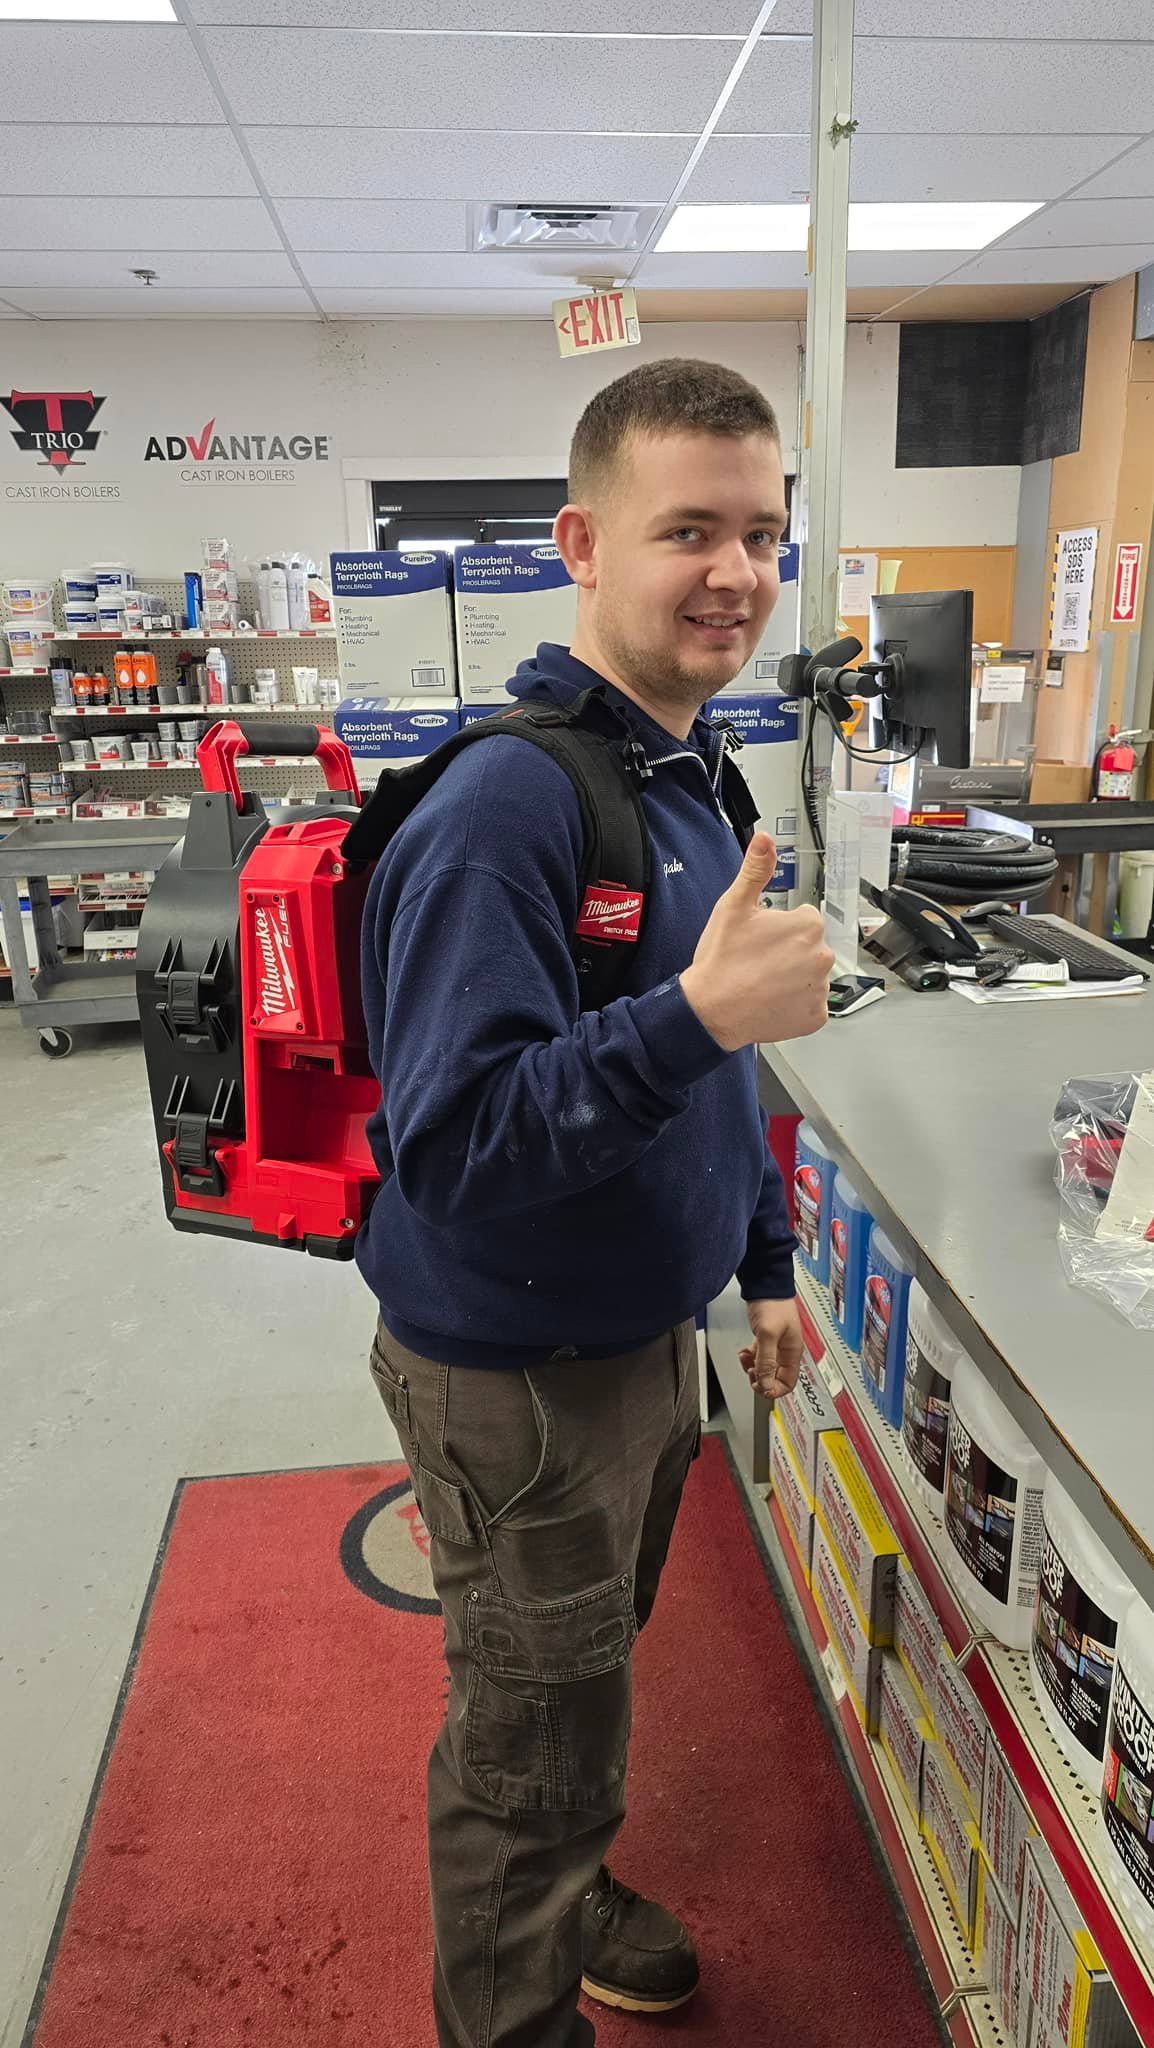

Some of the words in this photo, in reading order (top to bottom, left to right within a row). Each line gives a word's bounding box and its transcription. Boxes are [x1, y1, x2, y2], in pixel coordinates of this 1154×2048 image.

[569, 293, 624, 347] EXIT
[31, 432, 84, 450] TRIO
[144, 418, 329, 461] ADVANTAGE
[180, 469, 212, 482] CAST
[215, 469, 246, 482] IRON
[249, 469, 295, 482] BOILERS
[5, 486, 37, 498] CAST
[40, 486, 70, 498] IRON
[74, 486, 120, 498] BOILERS
[1063, 536, 1093, 554] ACCESS
[404, 555, 433, 563] PurePro
[461, 556, 513, 566] Absorbent
[1068, 554, 1083, 568] SDS
[1122, 553, 1136, 561] FIRE
[335, 561, 383, 571] Absorbent
[462, 566, 511, 577] Terrycloth
[514, 566, 540, 576] Rags
[336, 572, 382, 582] Terrycloth
[384, 571, 409, 580] Rags
[1065, 569, 1084, 584] HERE
[339, 607, 352, 615] For:
[345, 623, 368, 631] Heating
[470, 622, 495, 630] Heating
[711, 708, 760, 718] Absorbent
[341, 722, 393, 732] Absorbent
[761, 719, 785, 728] Rags
[342, 732, 391, 743] Terrycloth
[394, 732, 419, 742] Rags
[584, 898, 640, 917] Milwaukee
[279, 898, 291, 948] FUEL
[255, 907, 286, 1016] Milwaukee
[791, 1478, 802, 1501] PRO
[824, 1461, 848, 1510] G-FORCE
[847, 1512, 861, 1540] PRO
[820, 1544, 843, 1595] G-FORCE
[842, 1599, 856, 1628] PRO
[896, 1575, 921, 1619] G-FORCE
[920, 1621, 936, 1646] PRO
[939, 1663, 970, 1717] G-FORCE
[1079, 1687, 1101, 1714] PURPOSE
[903, 1718, 917, 1745] PRO
[926, 1760, 950, 1812] G-FORCE
[951, 1818, 966, 1850] PRO
[1061, 1974, 1072, 2019] PACK
[1057, 2003, 1068, 2046] 20
